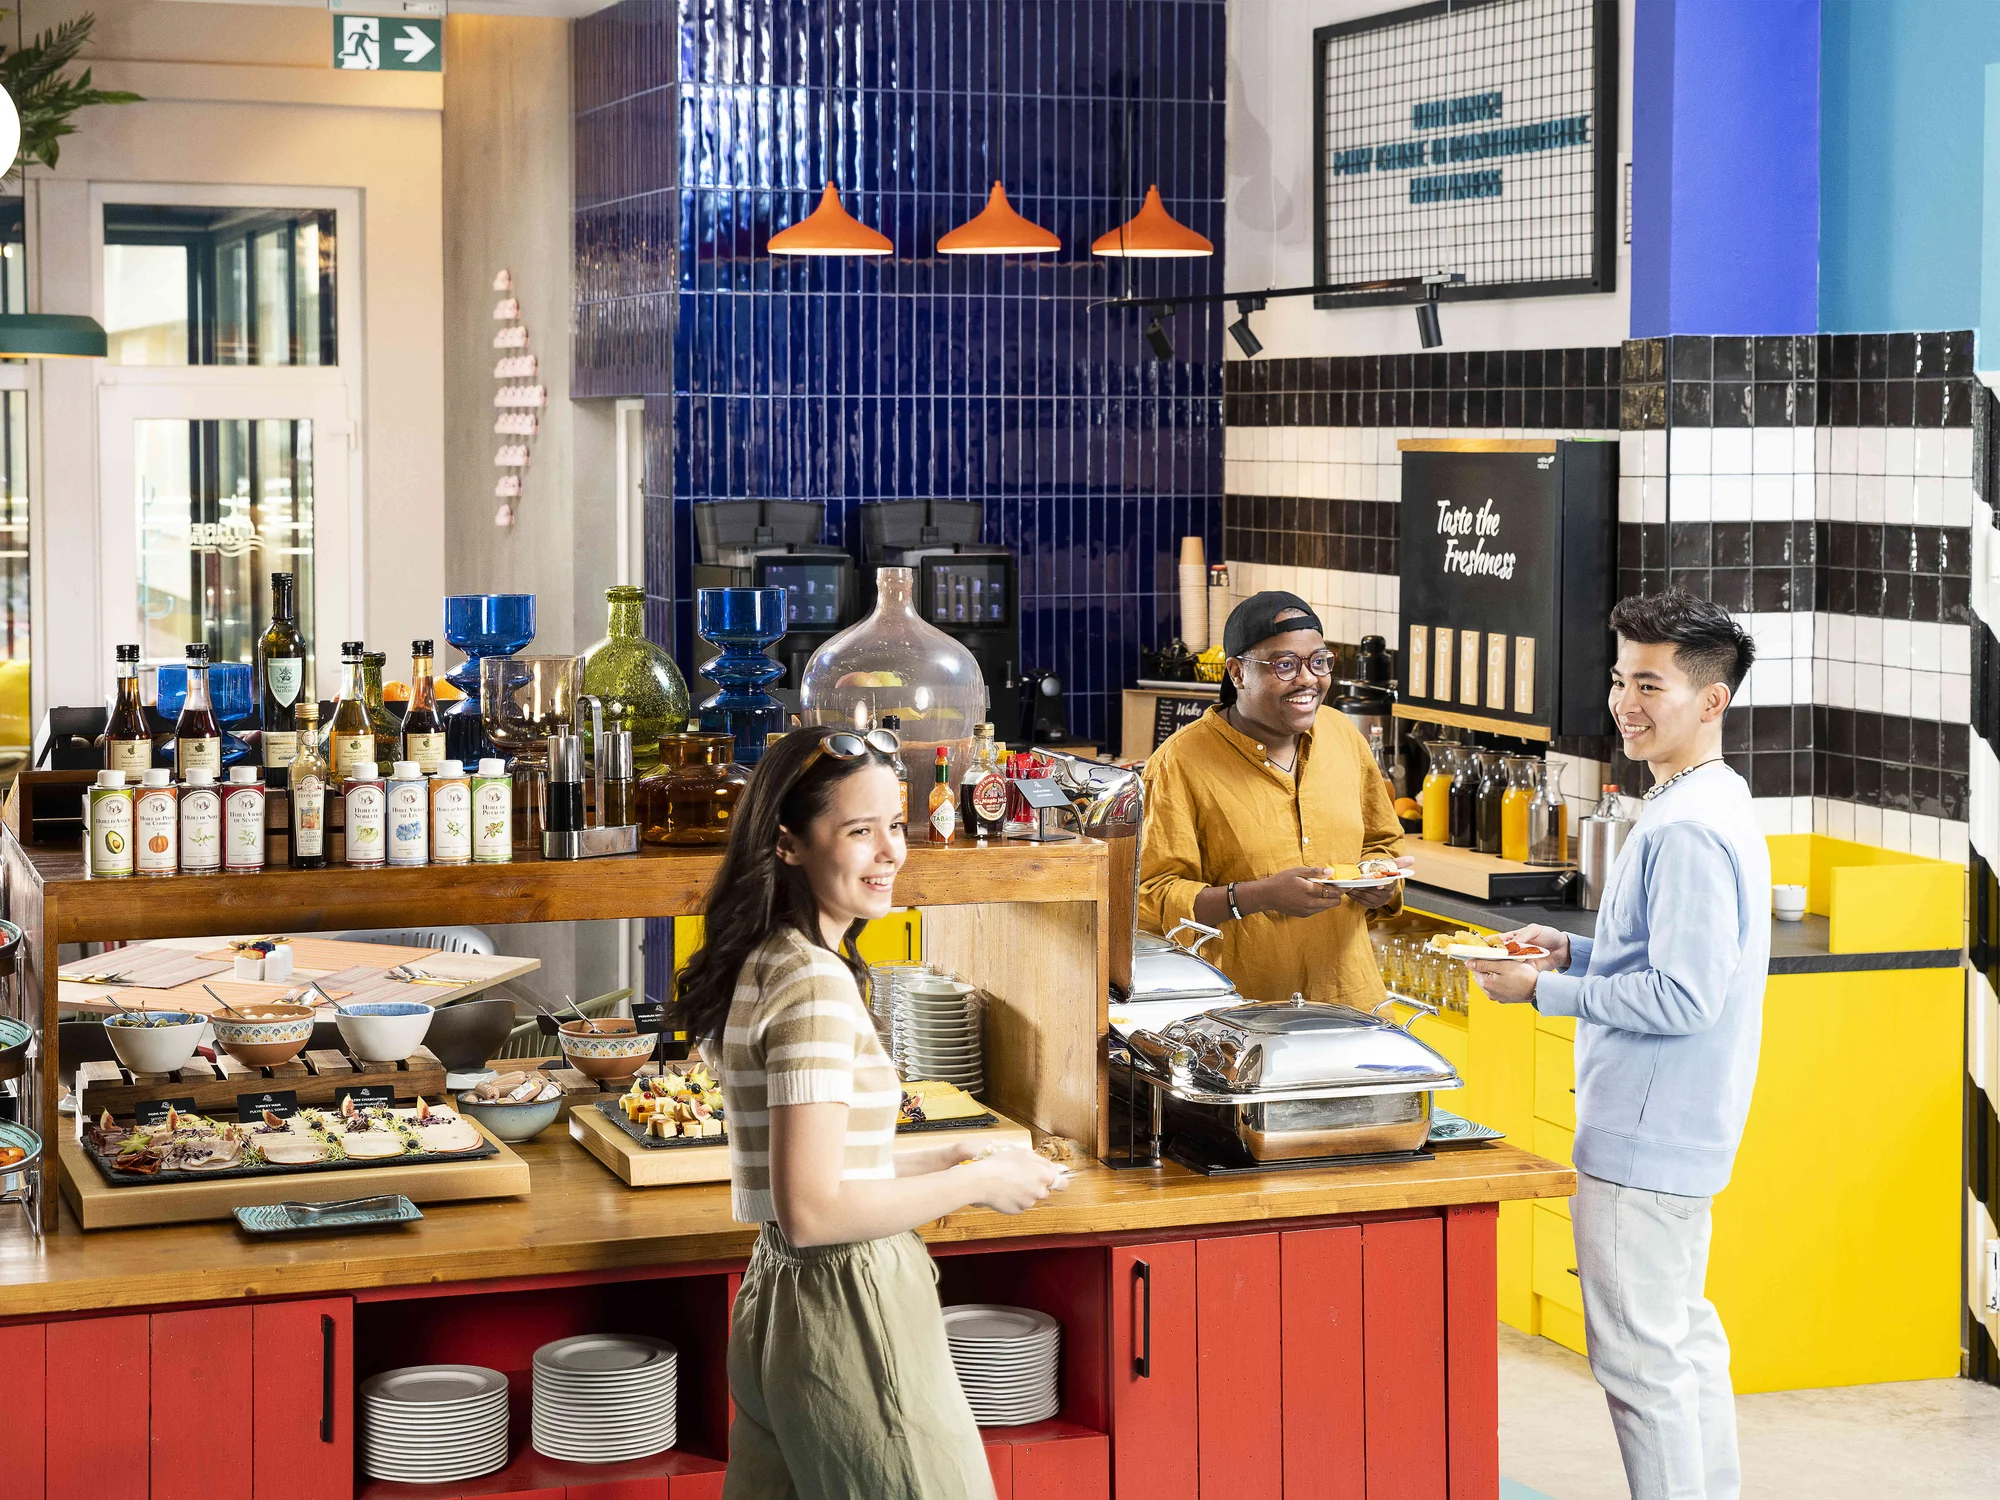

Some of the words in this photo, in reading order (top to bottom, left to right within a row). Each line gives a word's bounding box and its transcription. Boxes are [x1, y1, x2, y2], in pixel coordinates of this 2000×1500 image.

[1437, 499, 1473, 537] Taste
[1475, 498, 1501, 537] the
[1443, 537, 1517, 580] Freshness
[1176, 702, 1202, 717] Wake
